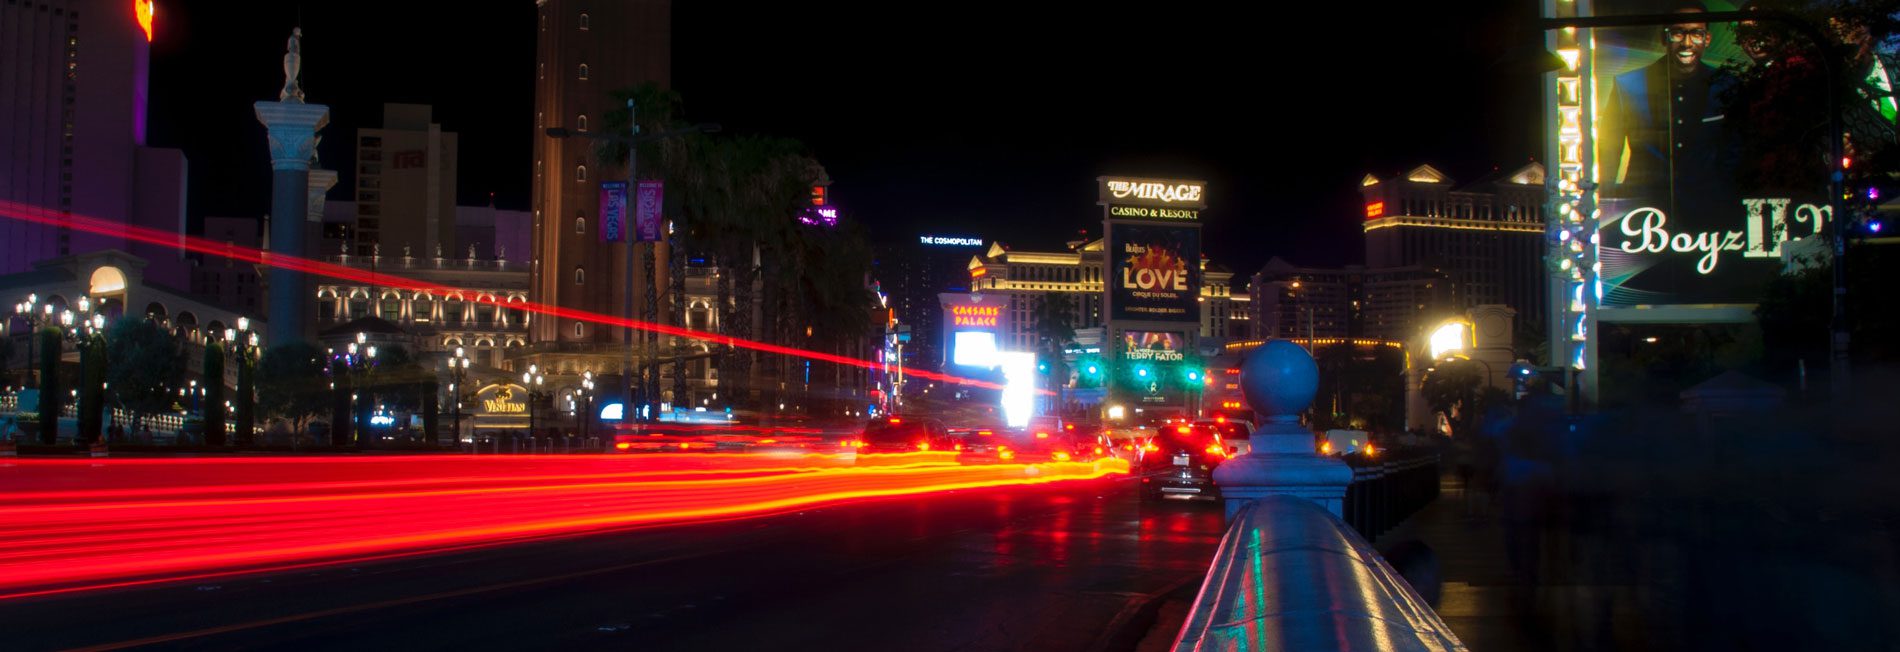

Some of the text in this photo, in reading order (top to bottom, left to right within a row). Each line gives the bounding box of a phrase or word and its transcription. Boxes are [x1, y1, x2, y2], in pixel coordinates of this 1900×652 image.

[1108, 181, 1202, 203] THE MIRAGE
[643, 189, 656, 221] VEGAS
[1111, 207, 1198, 219] CASINO & RESORT
[606, 208, 619, 240] VEGAS
[920, 236, 982, 246] THE COSMOPOLITAN
[1619, 206, 1745, 275] Boyz
[1742, 198, 1790, 258] II
[1123, 267, 1188, 291] LOVE
[953, 306, 999, 316] CAESARS
[955, 317, 997, 326] PALACE
[1126, 352, 1183, 361] TERRY FATOR
